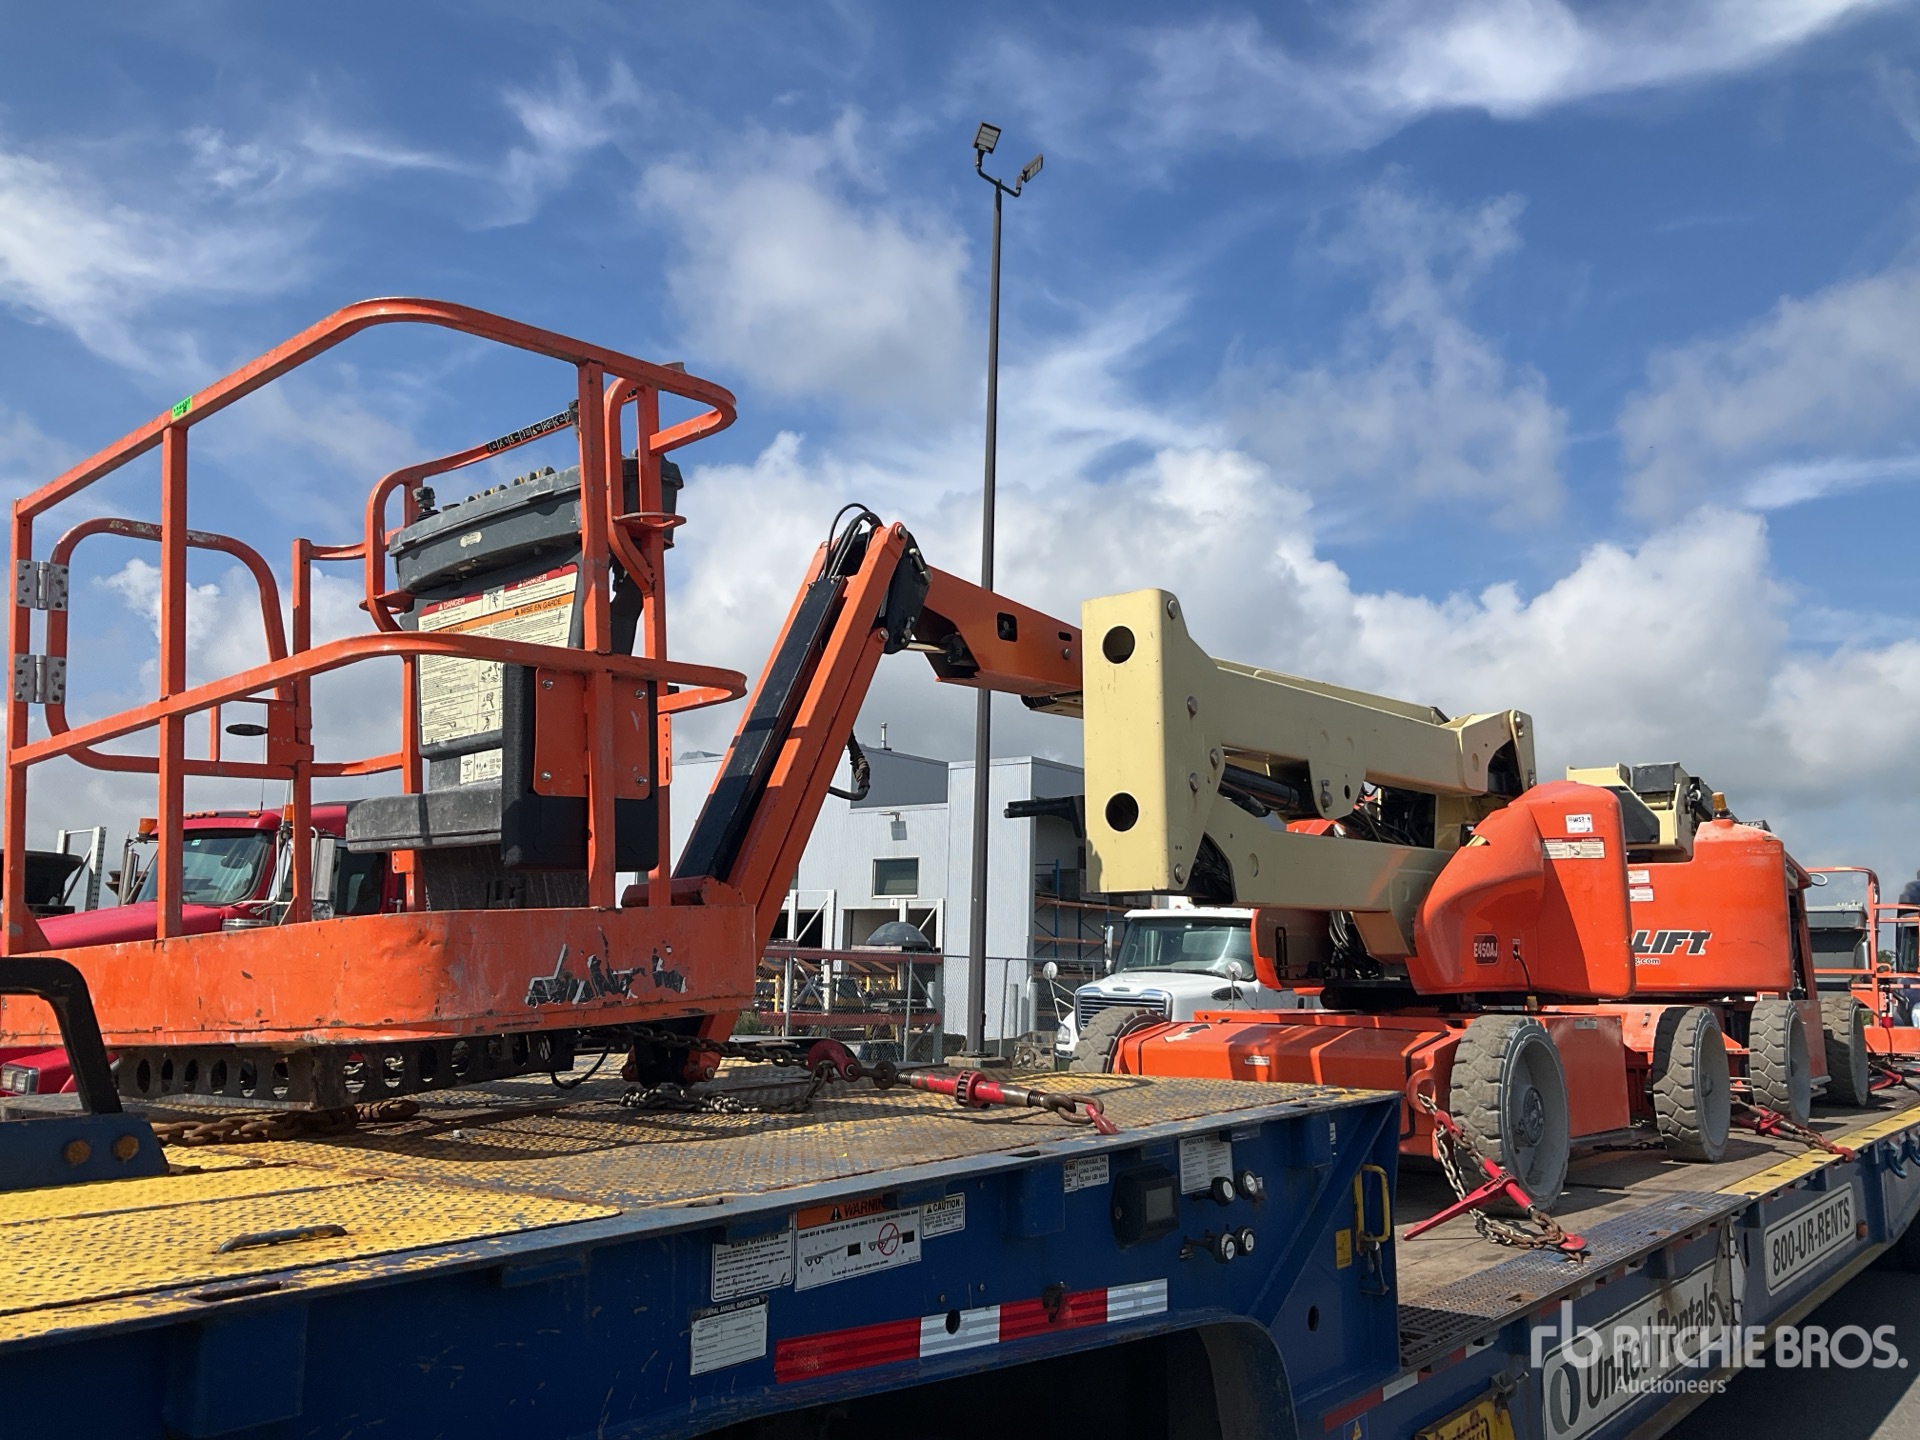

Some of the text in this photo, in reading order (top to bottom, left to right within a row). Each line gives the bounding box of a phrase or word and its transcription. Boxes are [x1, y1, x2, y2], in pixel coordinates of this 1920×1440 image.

[444, 598, 466, 610] DANGER
[521, 598, 562, 616] MISE EN GARDE
[1473, 942, 1498, 958] E450AJ
[1632, 930, 1713, 955] LIFT
[1634, 957, 1661, 966] g.com
[1183, 1137, 1204, 1146] OPERATION
[844, 1198, 884, 1217] WARNI
[933, 1197, 961, 1212] CAUTION
[1773, 1196, 1851, 1276] 800-UR-RENTS
[720, 1303, 736, 1312] ANNUAL
[736, 1297, 760, 1309] INSPECTION
[1587, 1282, 1716, 1409] United Rentals
